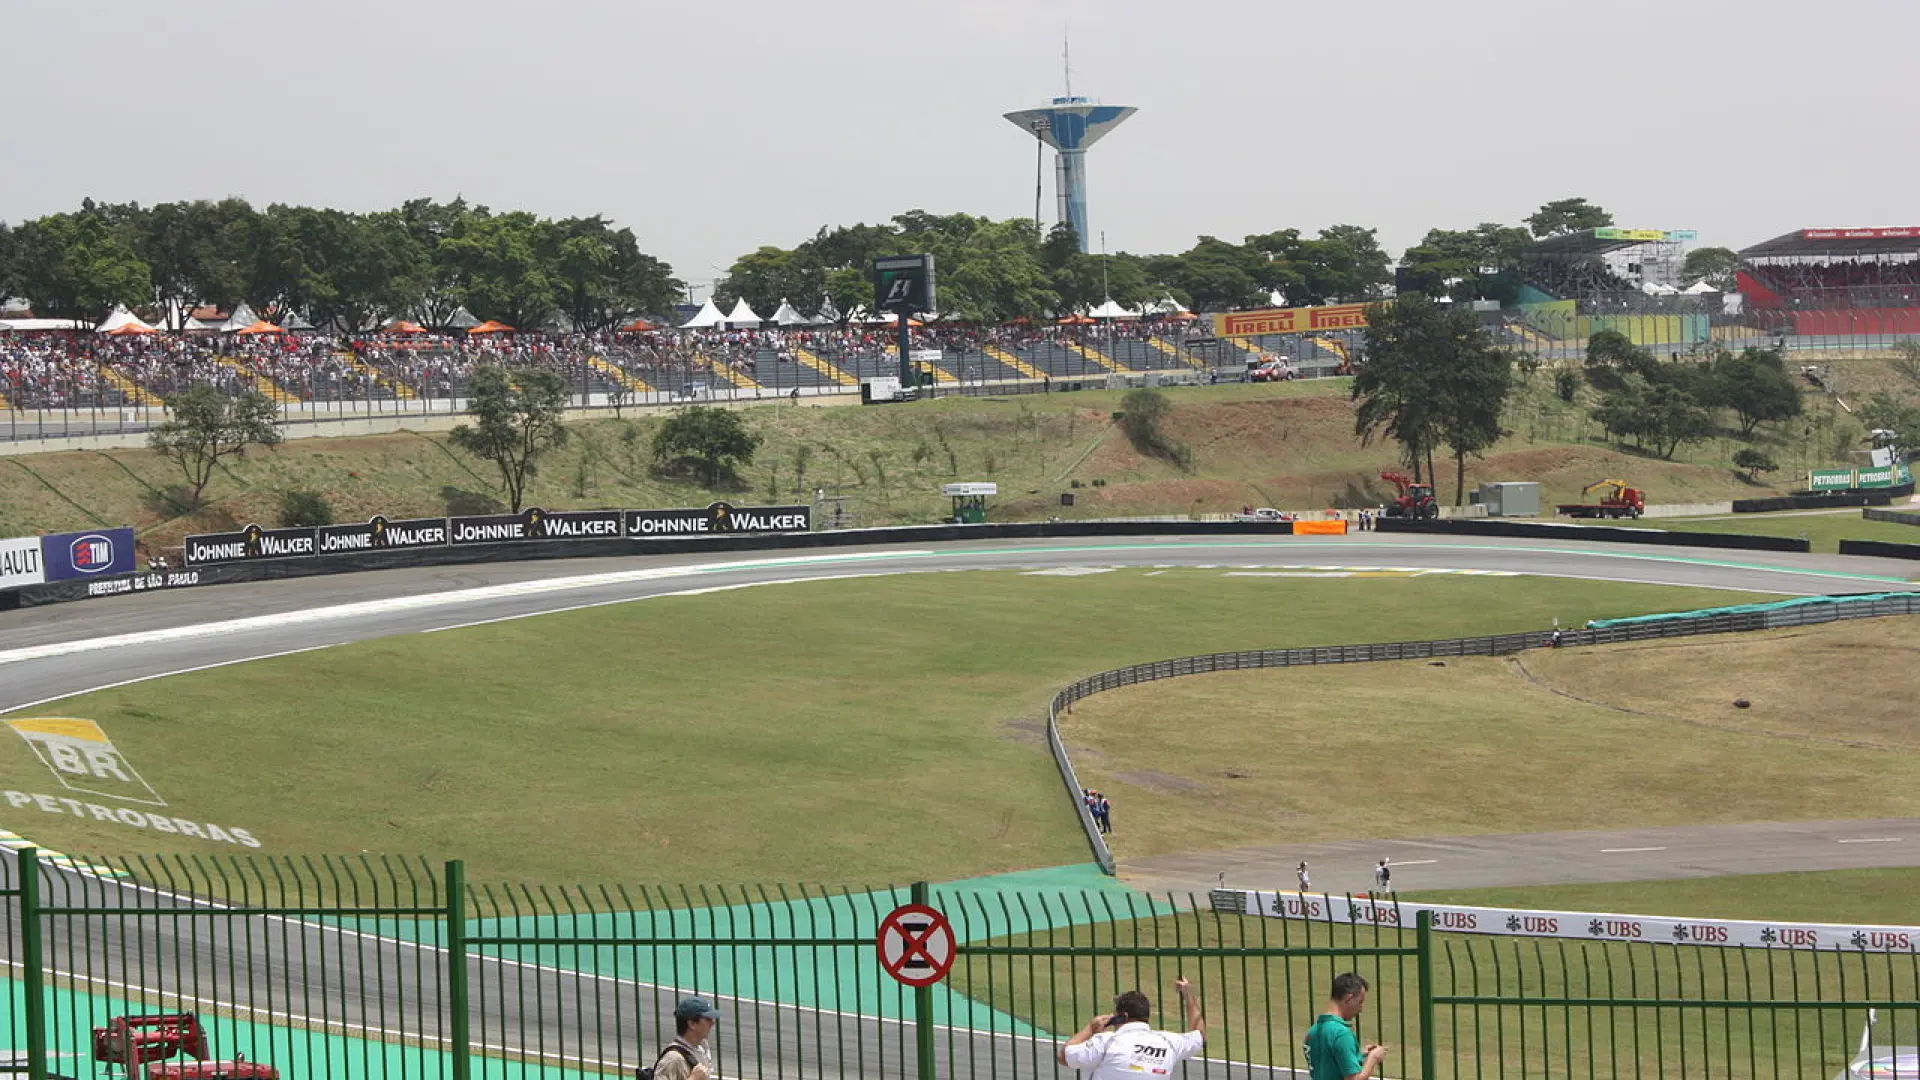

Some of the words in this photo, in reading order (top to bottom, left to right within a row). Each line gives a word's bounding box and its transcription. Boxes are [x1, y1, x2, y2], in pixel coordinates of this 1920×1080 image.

[1225, 312, 1294, 334] PIRELLI
[1310, 303, 1370, 328] PIREL
[1813, 474, 1850, 485] PETROBRAS
[1860, 471, 1890, 482] PETROBRAS
[454, 523, 524, 541] JOHNNIE
[543, 518, 618, 536] WALKER
[629, 516, 709, 533] JOHNNIE
[730, 513, 806, 530] WALKER
[188, 541, 246, 562] JOHNNIE
[260, 536, 313, 554] WALKER
[321, 532, 372, 551] JOHNNIE
[386, 526, 445, 545] WALKER
[0, 548, 38, 576] AULT
[89, 541, 109, 564] TIM
[134, 577, 145, 590] DE
[167, 571, 199, 586] PAULO
[46, 740, 131, 782] BR
[4, 790, 262, 848] PETROBRAS
[1288, 900, 1320, 916] UBS
[1364, 906, 1398, 923] UBS
[1443, 912, 1477, 928] UBS
[1523, 916, 1558, 933] UBS
[1606, 920, 1642, 938] UBS
[1691, 925, 1728, 942] UBS
[1779, 929, 1817, 945] UBS
[1870, 932, 1909, 949] UBS
